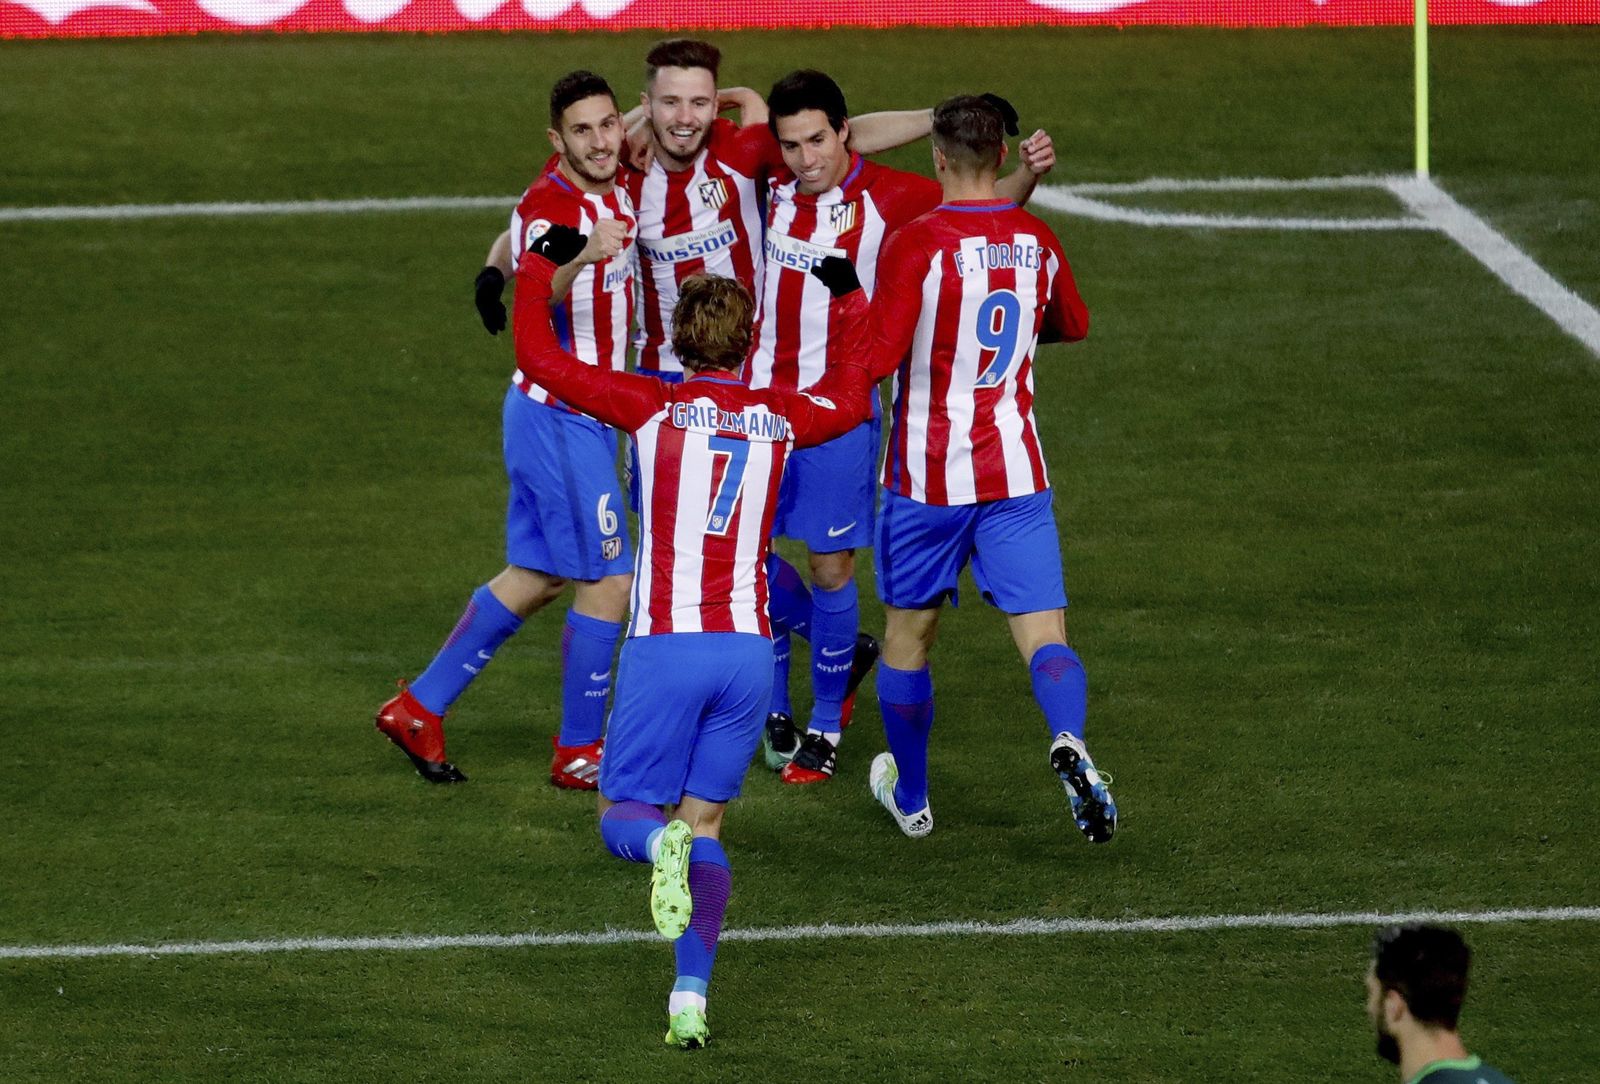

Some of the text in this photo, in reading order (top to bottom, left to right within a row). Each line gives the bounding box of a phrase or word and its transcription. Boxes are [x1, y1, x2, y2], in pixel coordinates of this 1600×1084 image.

[766, 239, 823, 270] Plus50
[976, 243, 1043, 271] TORRES
[974, 289, 1021, 388] 9
[673, 402, 787, 442] GRIEZMANN
[706, 434, 751, 536] 7
[597, 492, 618, 536] 6
